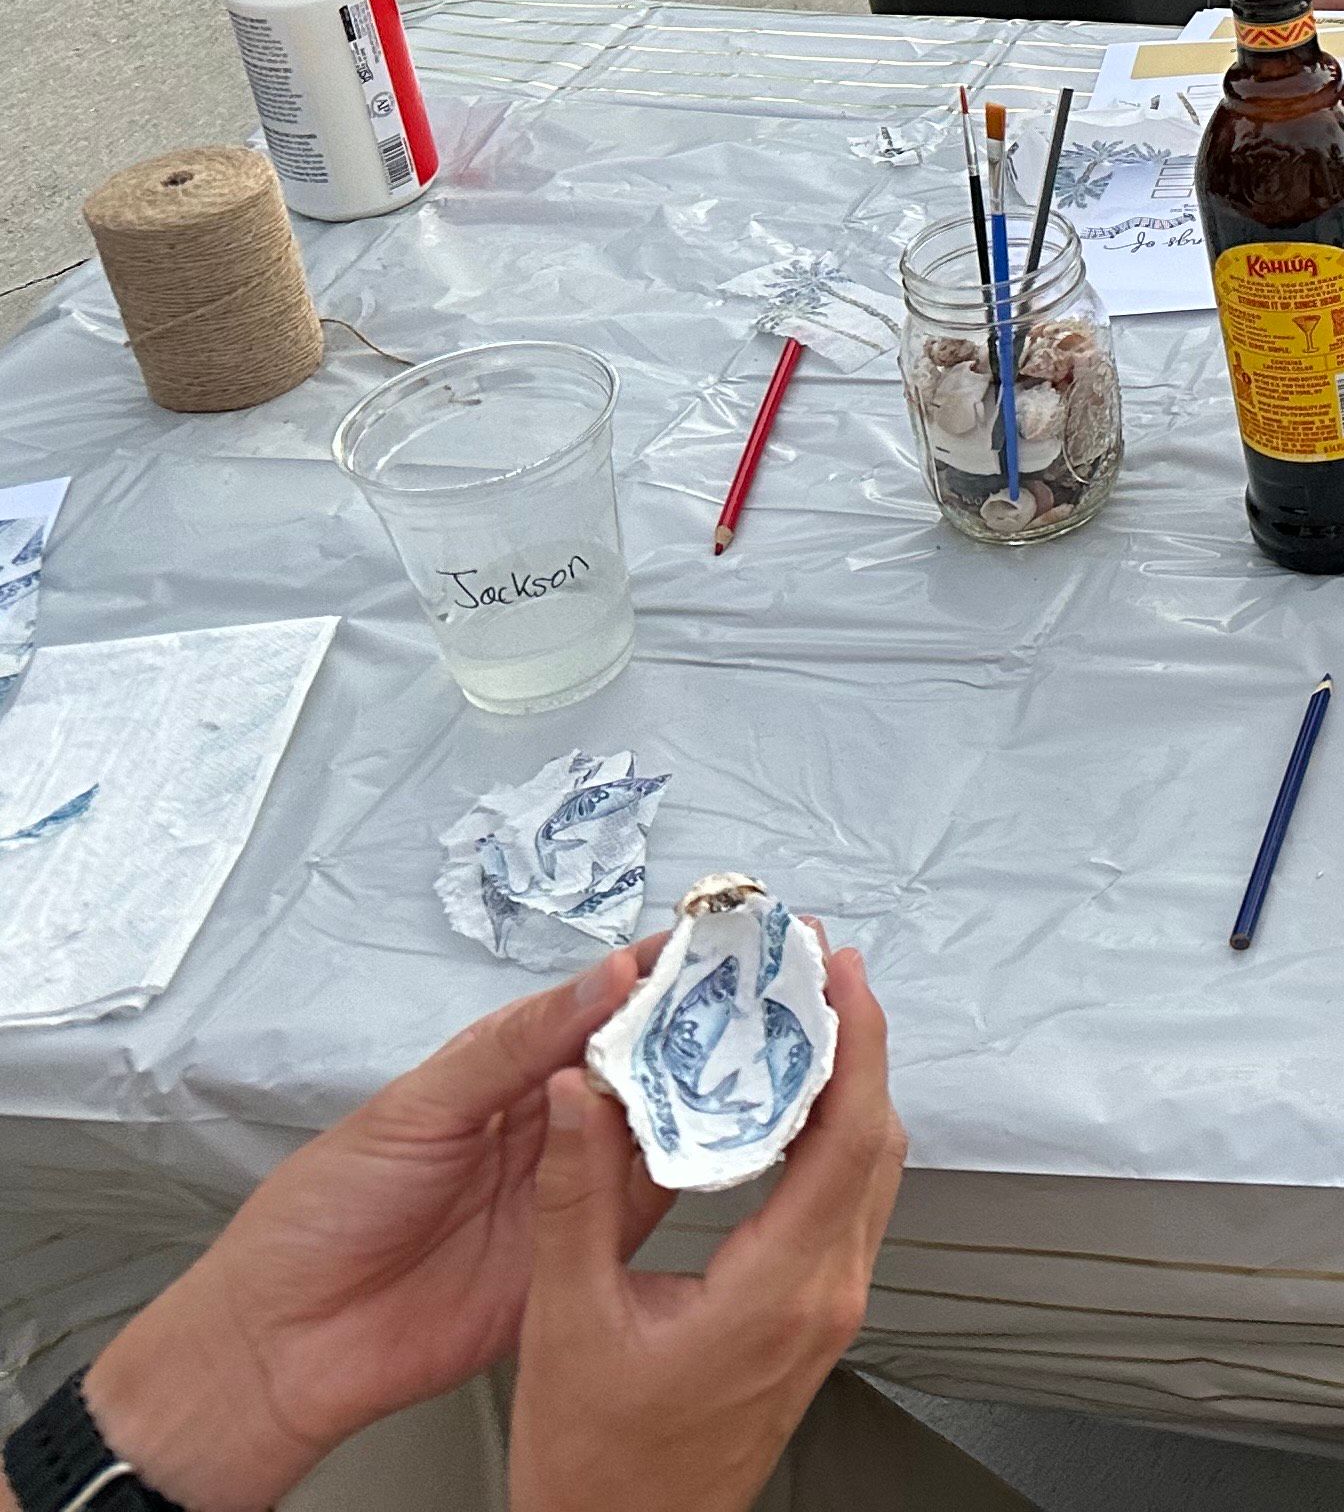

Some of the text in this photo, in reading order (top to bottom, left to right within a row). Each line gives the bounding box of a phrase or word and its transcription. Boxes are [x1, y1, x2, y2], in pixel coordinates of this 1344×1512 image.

[377, 98, 392, 114] AP
[1162, 228, 1205, 247] ngs
[435, 554, 589, 609] Jackson
